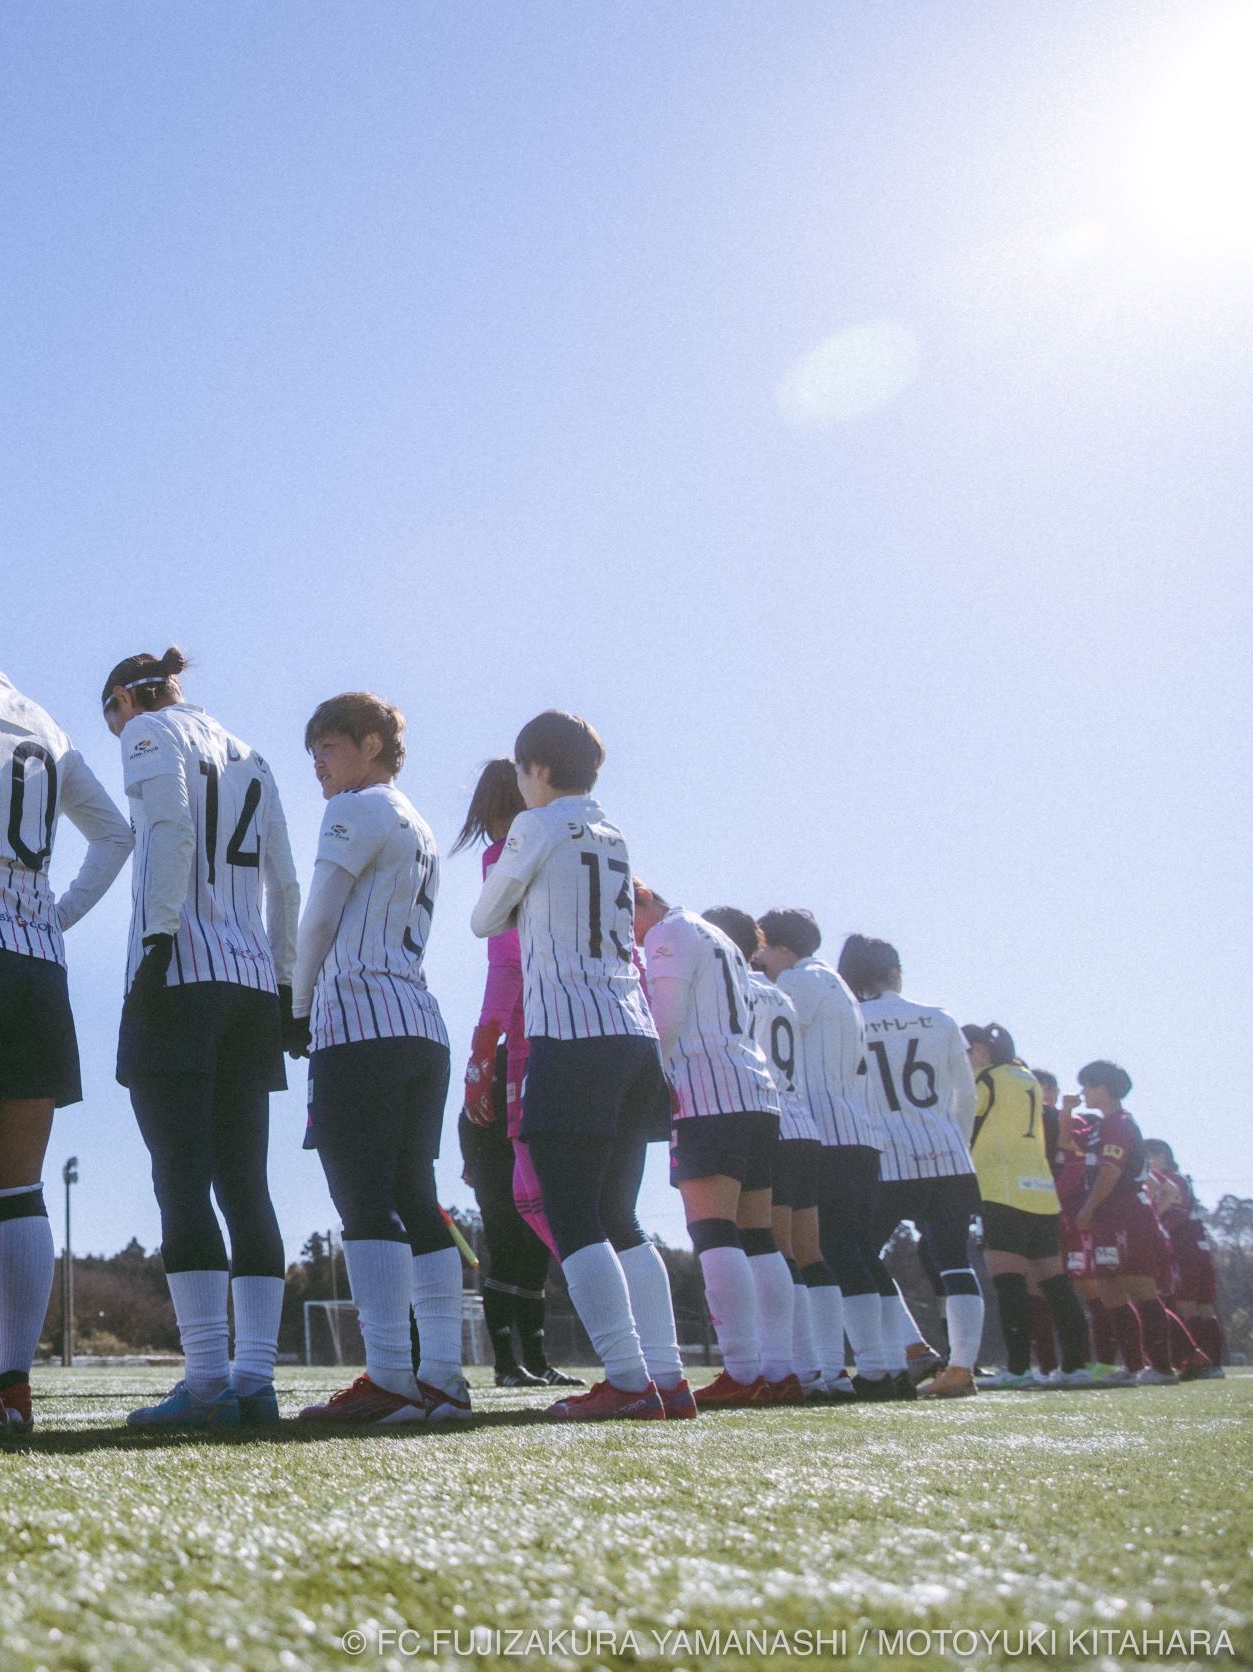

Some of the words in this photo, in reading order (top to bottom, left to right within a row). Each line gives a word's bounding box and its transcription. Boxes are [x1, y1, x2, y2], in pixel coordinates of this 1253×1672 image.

[581, 851, 633, 963] 13
[867, 1038, 939, 1112] 16
[1022, 1088, 1036, 1139] 1
